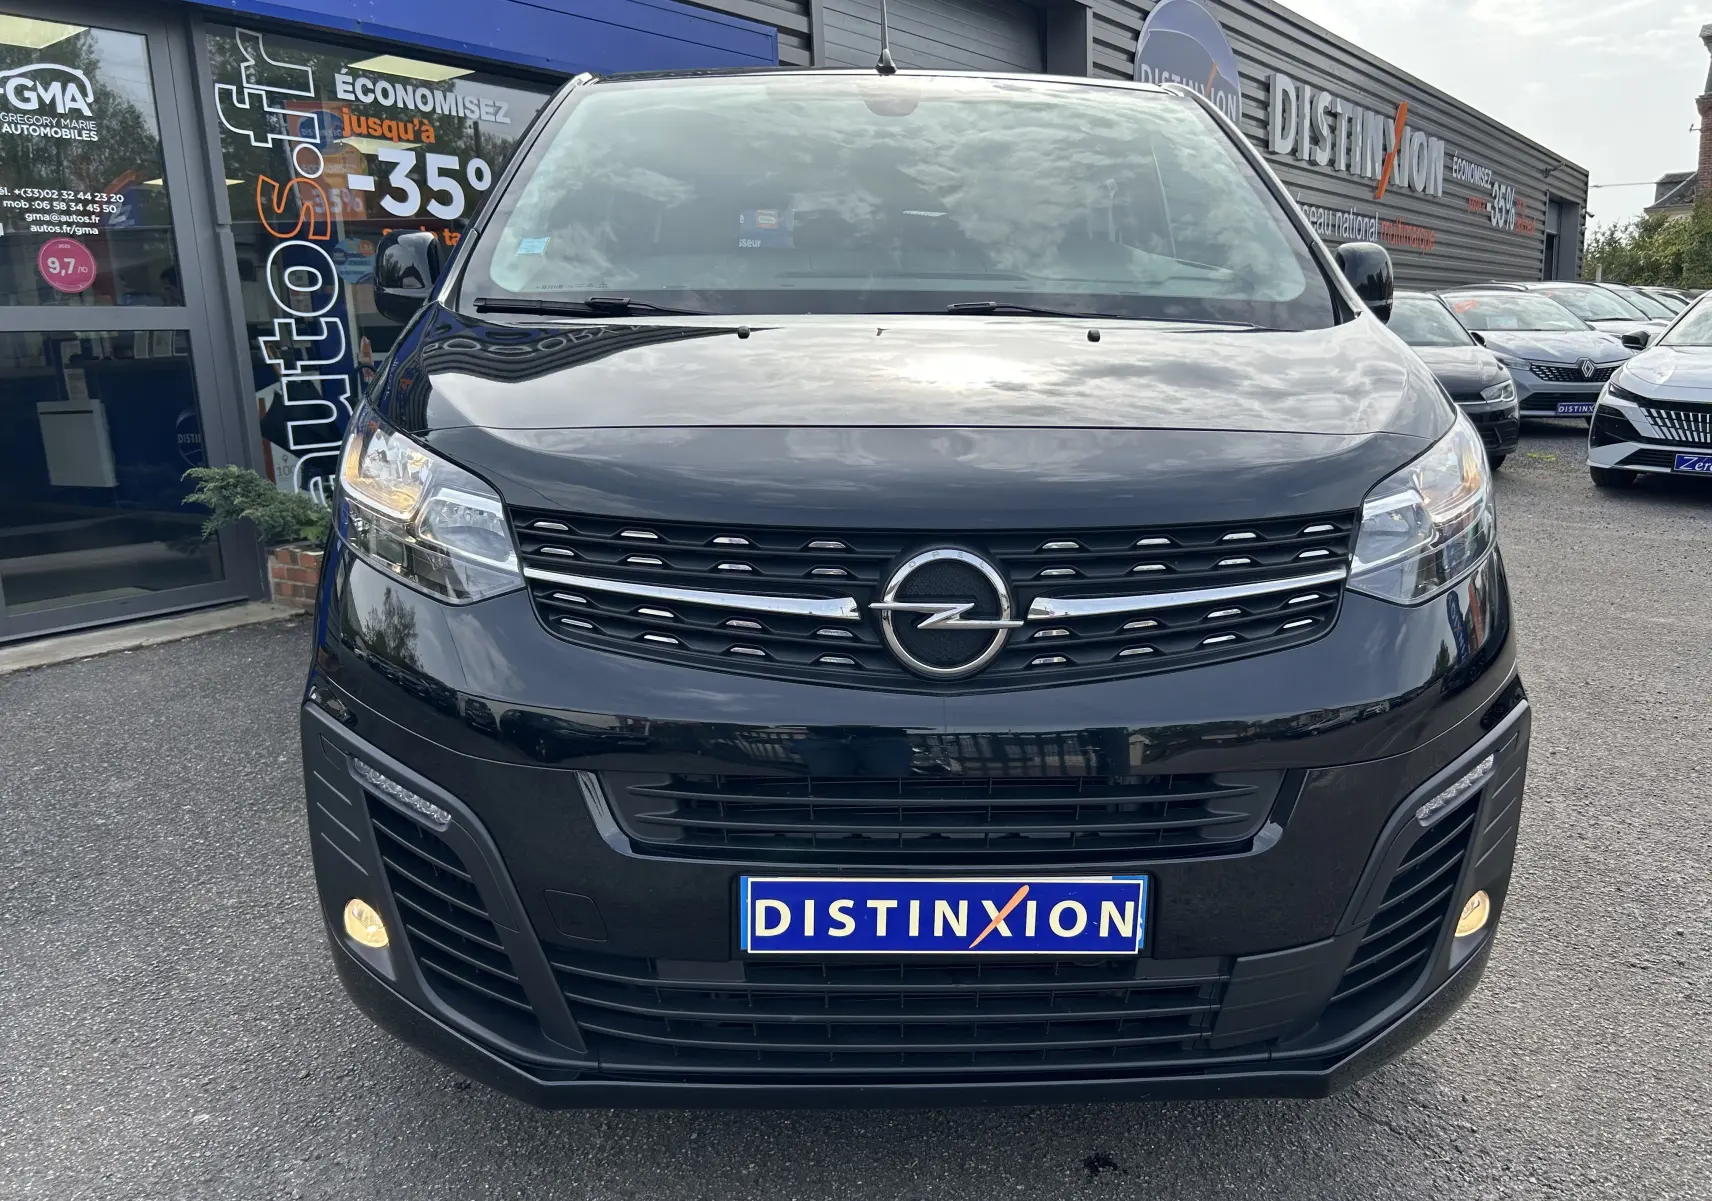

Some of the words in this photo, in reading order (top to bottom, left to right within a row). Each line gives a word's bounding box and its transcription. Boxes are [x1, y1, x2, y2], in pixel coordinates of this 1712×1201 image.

[5, 77, 93, 116] GMA
[335, 69, 511, 123] ÉCONOMISEZ
[0, 112, 57, 126] GREGORY
[61, 118, 97, 130] MARIE
[342, 107, 435, 143] jusqu'à
[2, 123, 98, 141] AUTOMOBILES
[1269, 73, 1445, 199] DISTINXION
[1452, 150, 1492, 189] ÉCONOMISEZ
[13, 188, 59, 199] +(33)02
[61, 190, 74, 199] 32
[77, 191, 91, 200] 44
[94, 193, 107, 201] 23
[110, 194, 124, 203] 20
[3, 199, 29, 209] mob
[53, 202, 67, 210] 58
[69, 203, 83, 211] 34
[86, 204, 100, 212] 45
[103, 205, 117, 213] 50
[25, 213, 100, 223] gma@autos.fr
[1336, 207, 1378, 242] national
[31, 224, 99, 235] autos.fr/gma
[47, 257, 75, 276] 9,7
[1558, 404, 1595, 413] DISTINX
[755, 885, 1135, 949] DISTINXION
